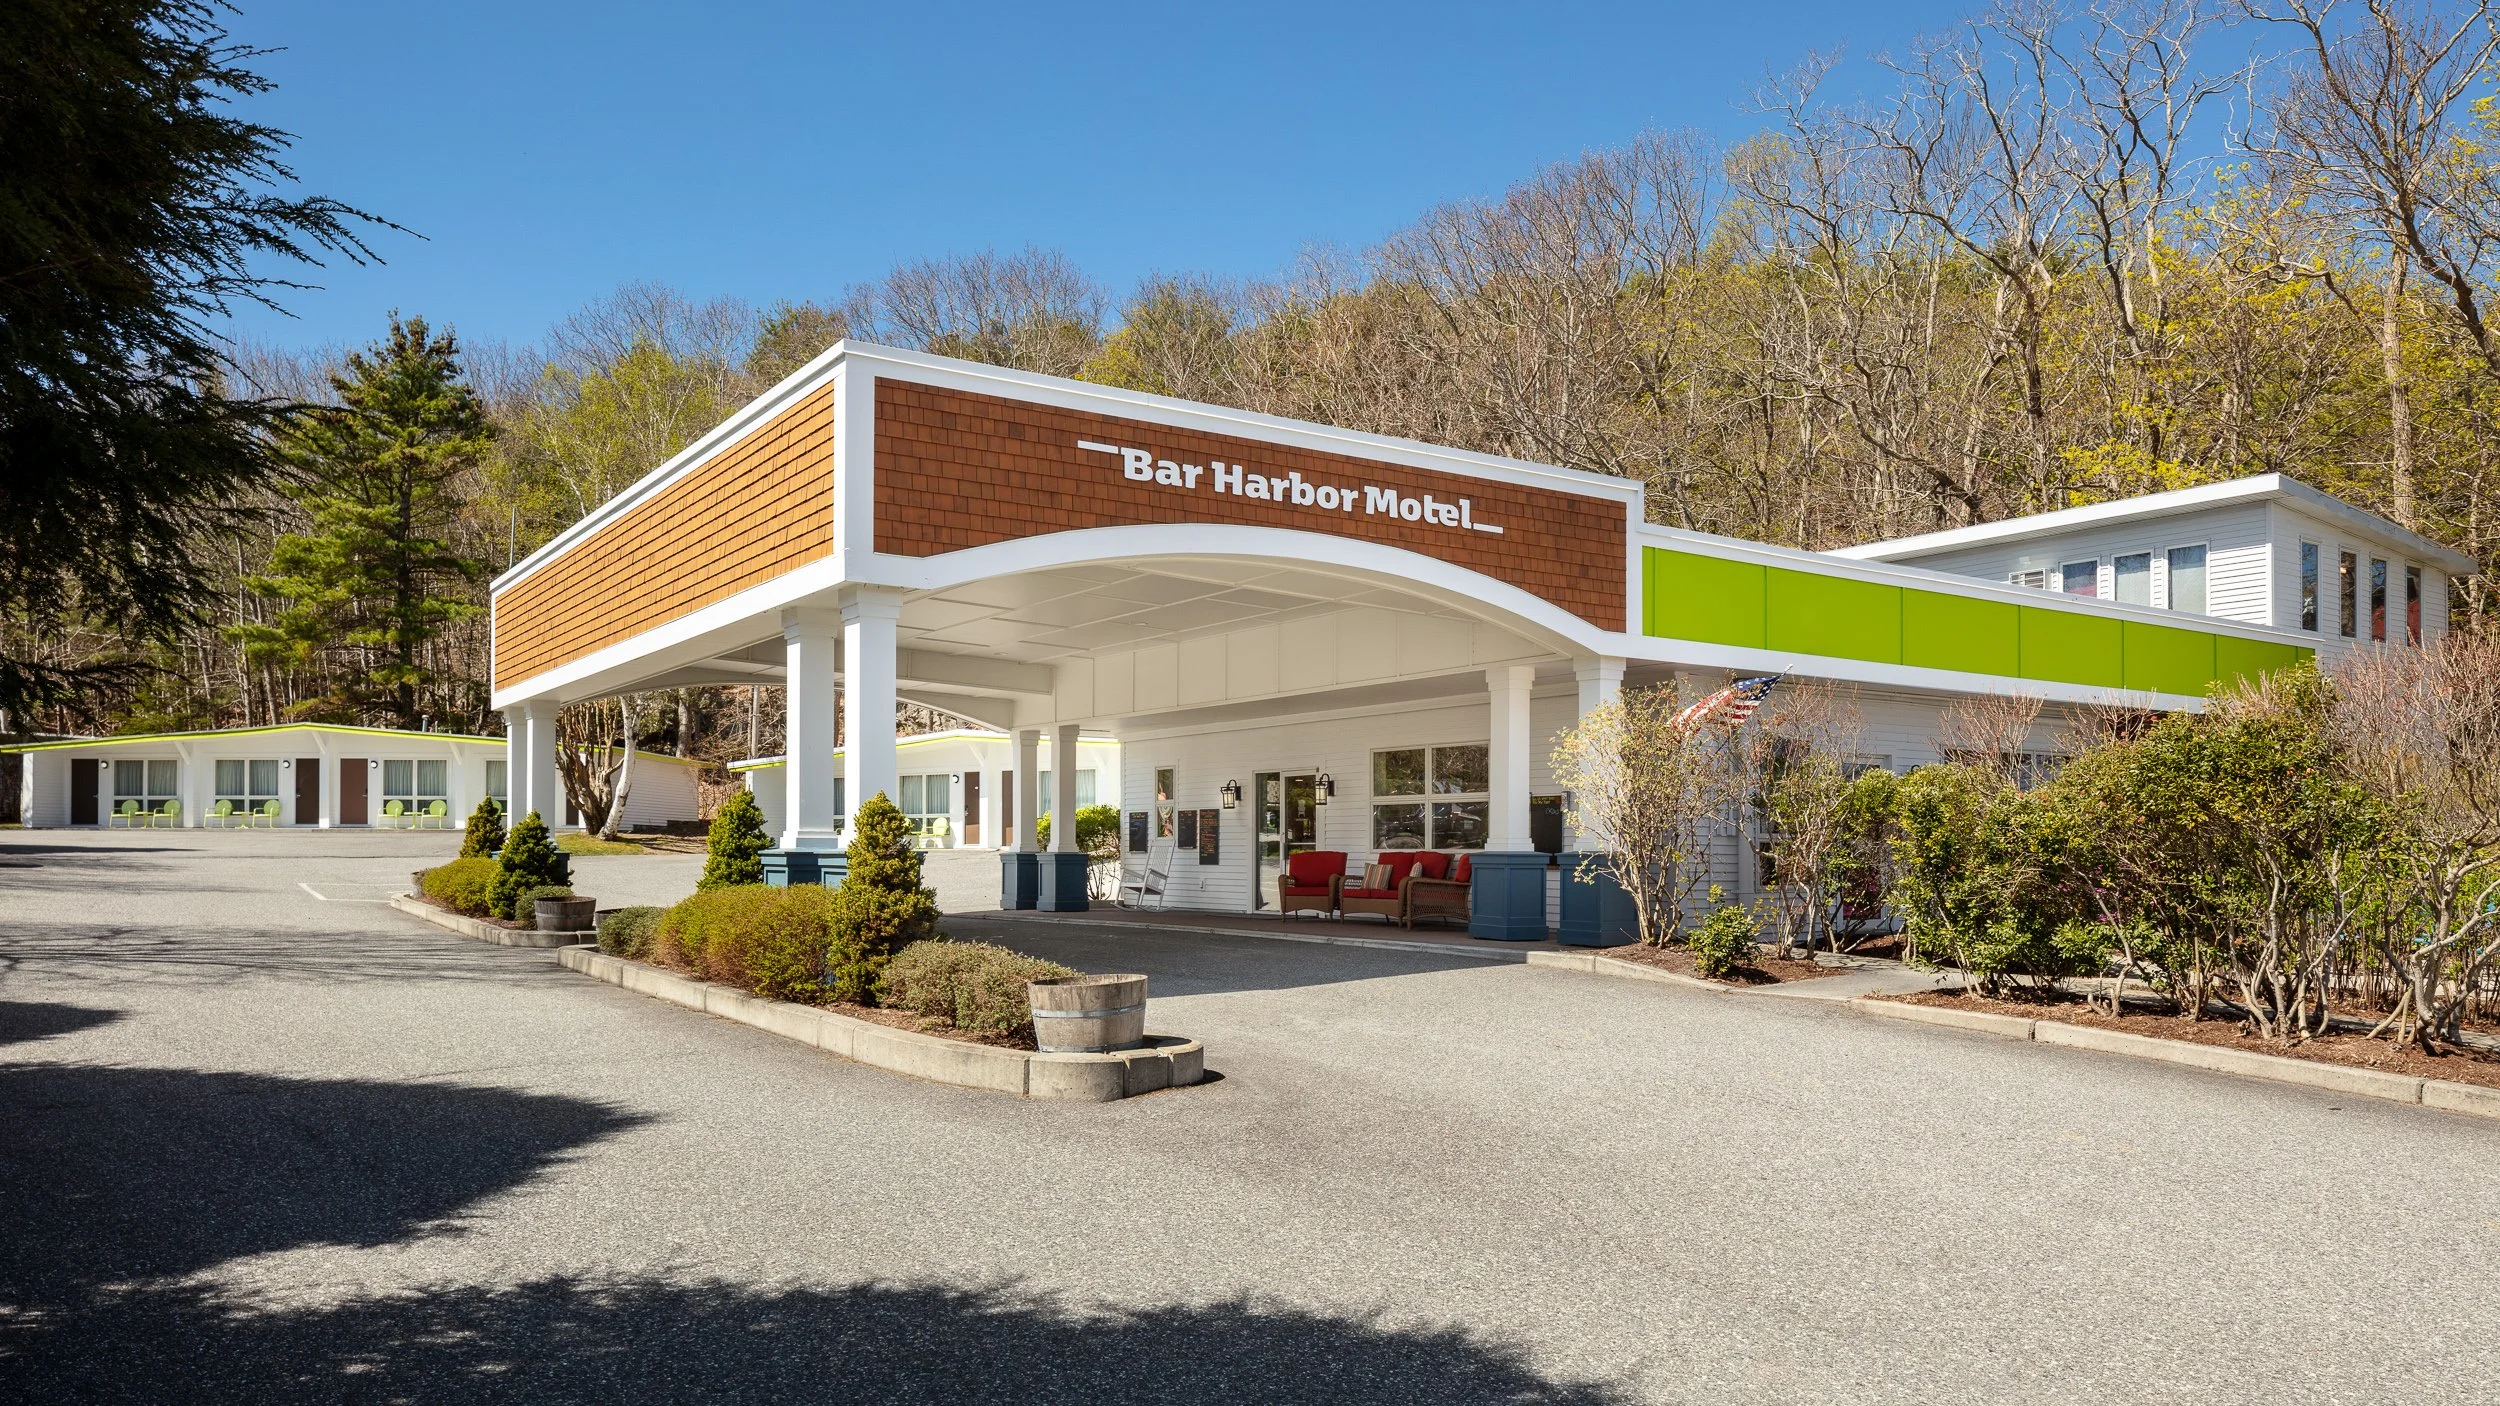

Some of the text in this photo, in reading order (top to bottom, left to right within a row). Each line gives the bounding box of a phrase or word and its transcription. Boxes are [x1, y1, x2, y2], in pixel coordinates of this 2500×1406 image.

[1120, 446, 1472, 530] Bar Harbor Motel
